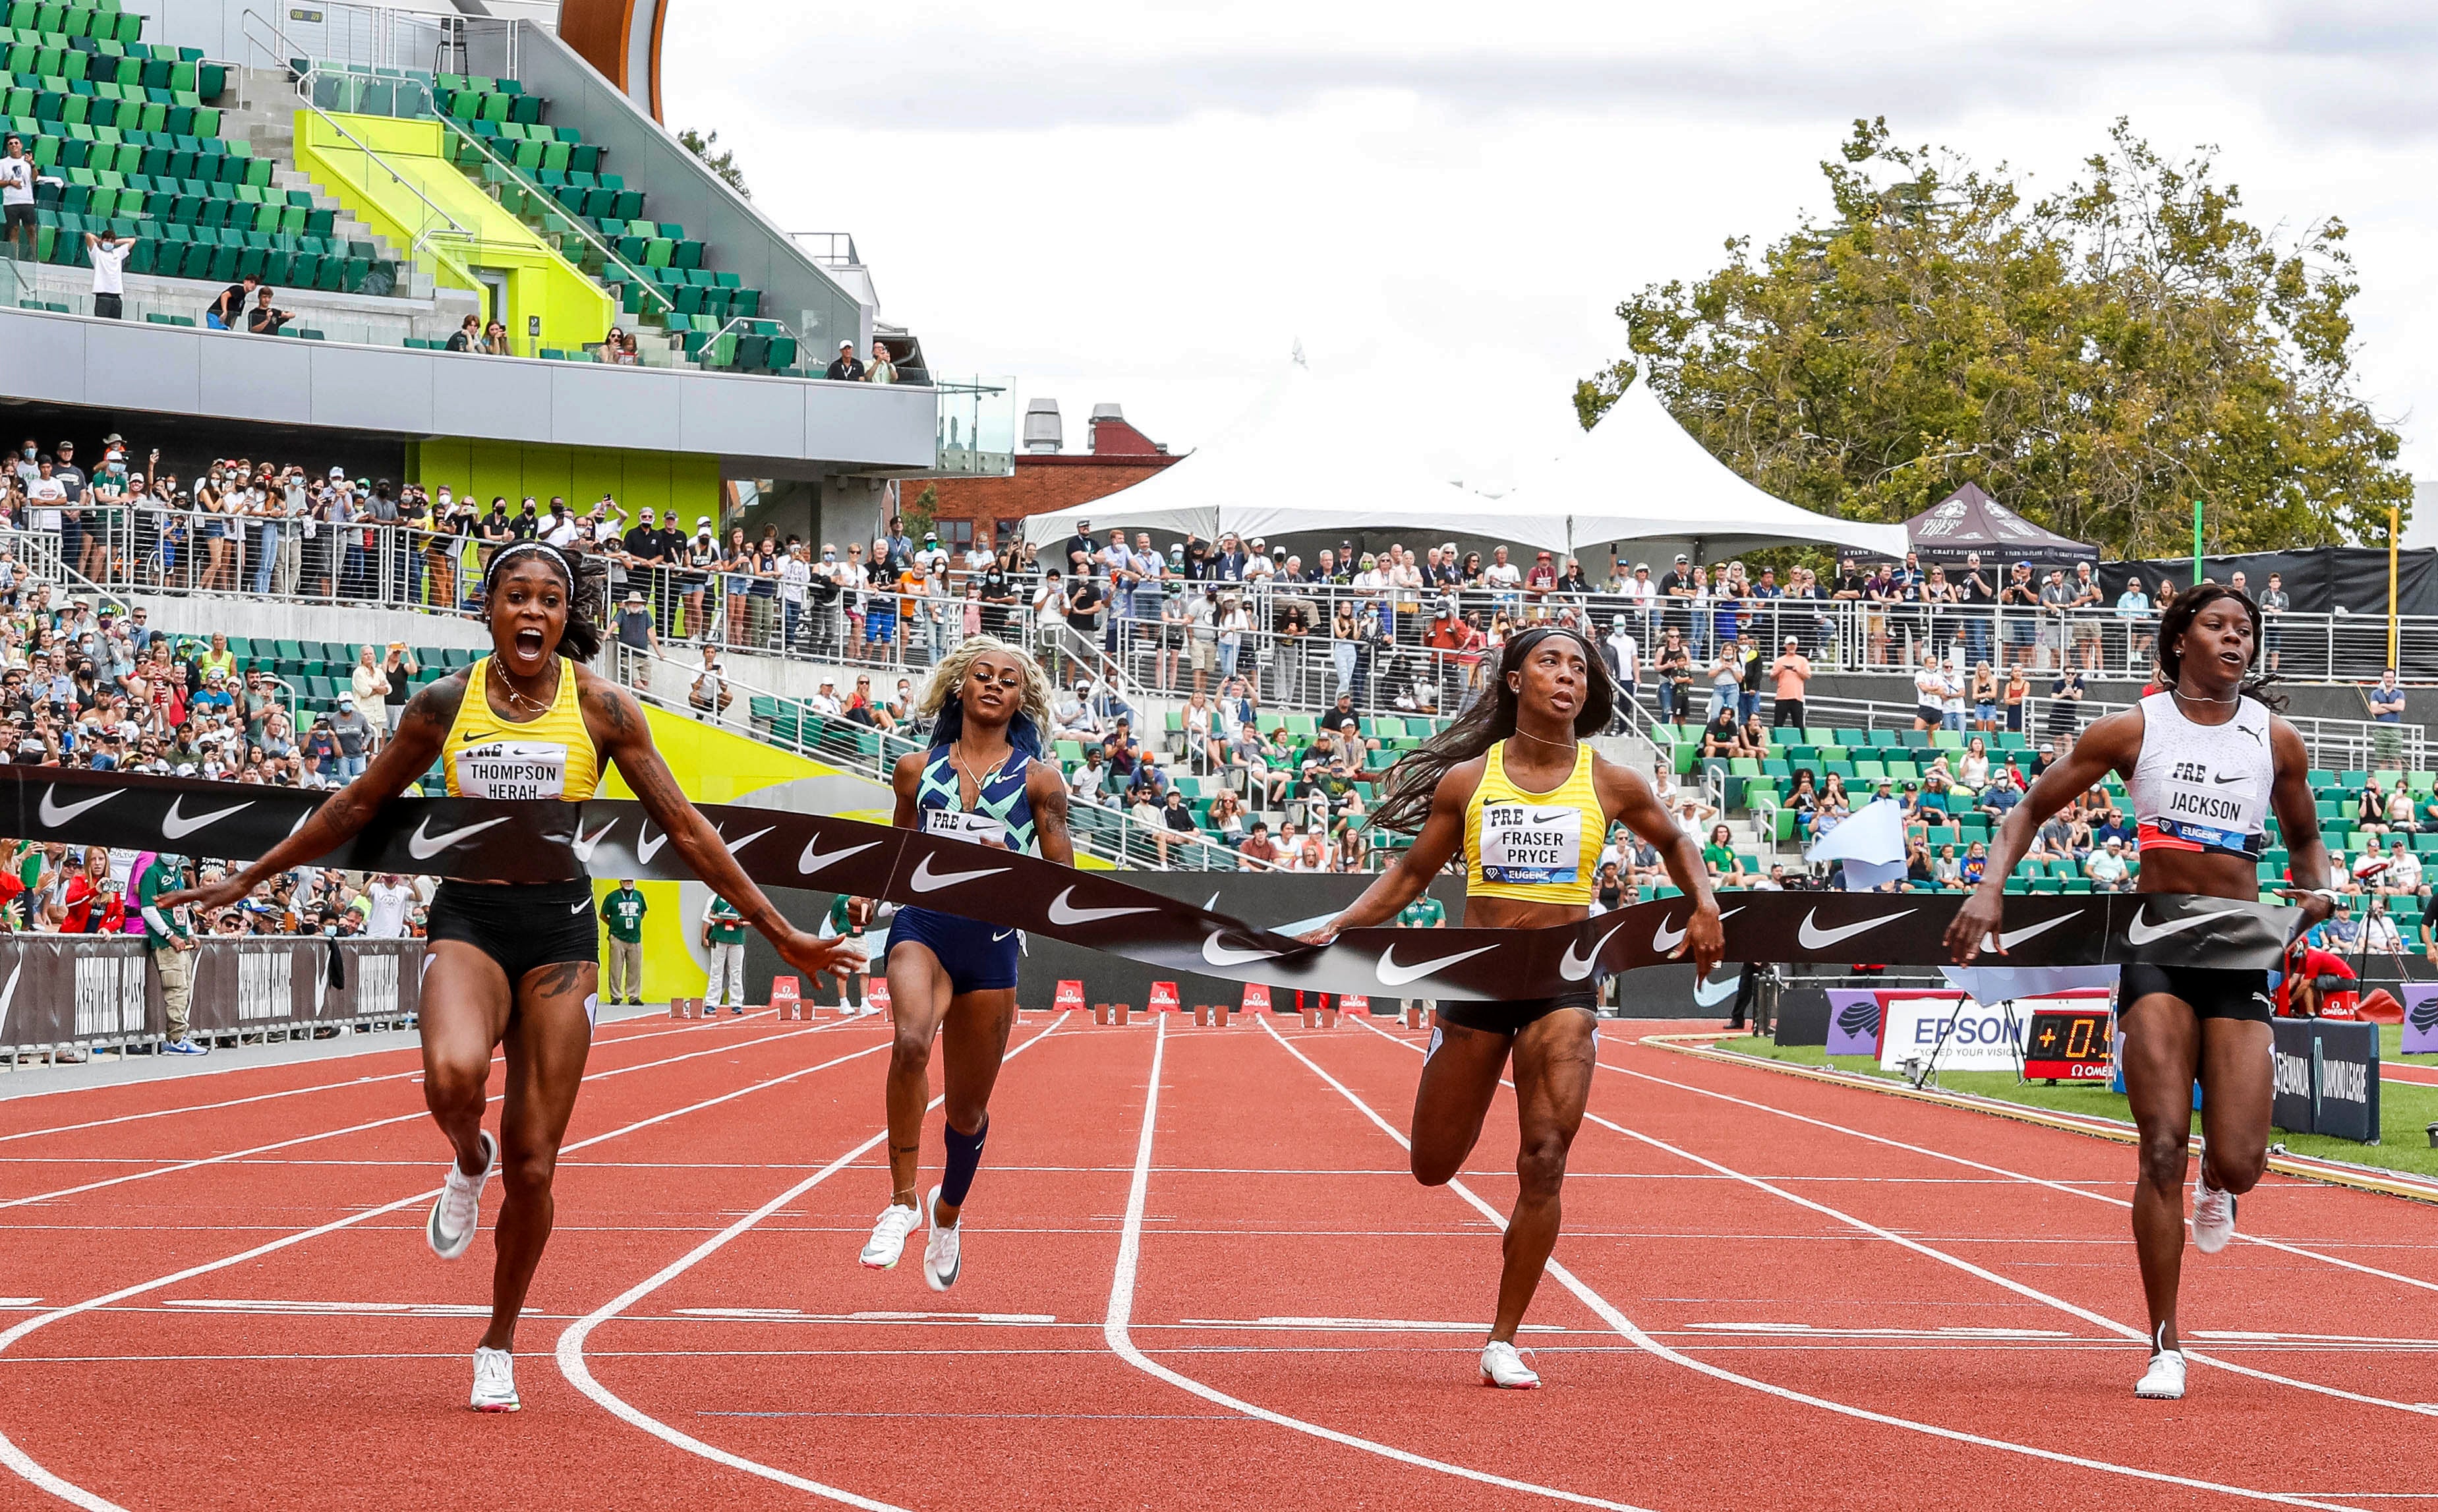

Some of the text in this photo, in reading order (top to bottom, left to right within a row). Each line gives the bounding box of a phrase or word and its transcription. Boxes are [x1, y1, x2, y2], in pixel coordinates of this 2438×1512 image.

[471, 764, 557, 781] THOMPSON
[2172, 763, 2207, 783] PRE
[488, 783, 538, 800] HERAH
[2170, 792, 2242, 822] JACKSON
[933, 812, 960, 830] PRE
[1491, 809, 1524, 827] PRE
[1502, 831, 1564, 846] FRASER
[2181, 826, 2222, 841] EUGENE
[1507, 849, 1559, 863] PRYCE
[1508, 869, 1550, 880] EUGENE
[1915, 1018, 2024, 1044] EPSON
[1956, 1048, 1983, 1057] YOUR
[2323, 1059, 2367, 1104] DIAMOND LEAGUE
